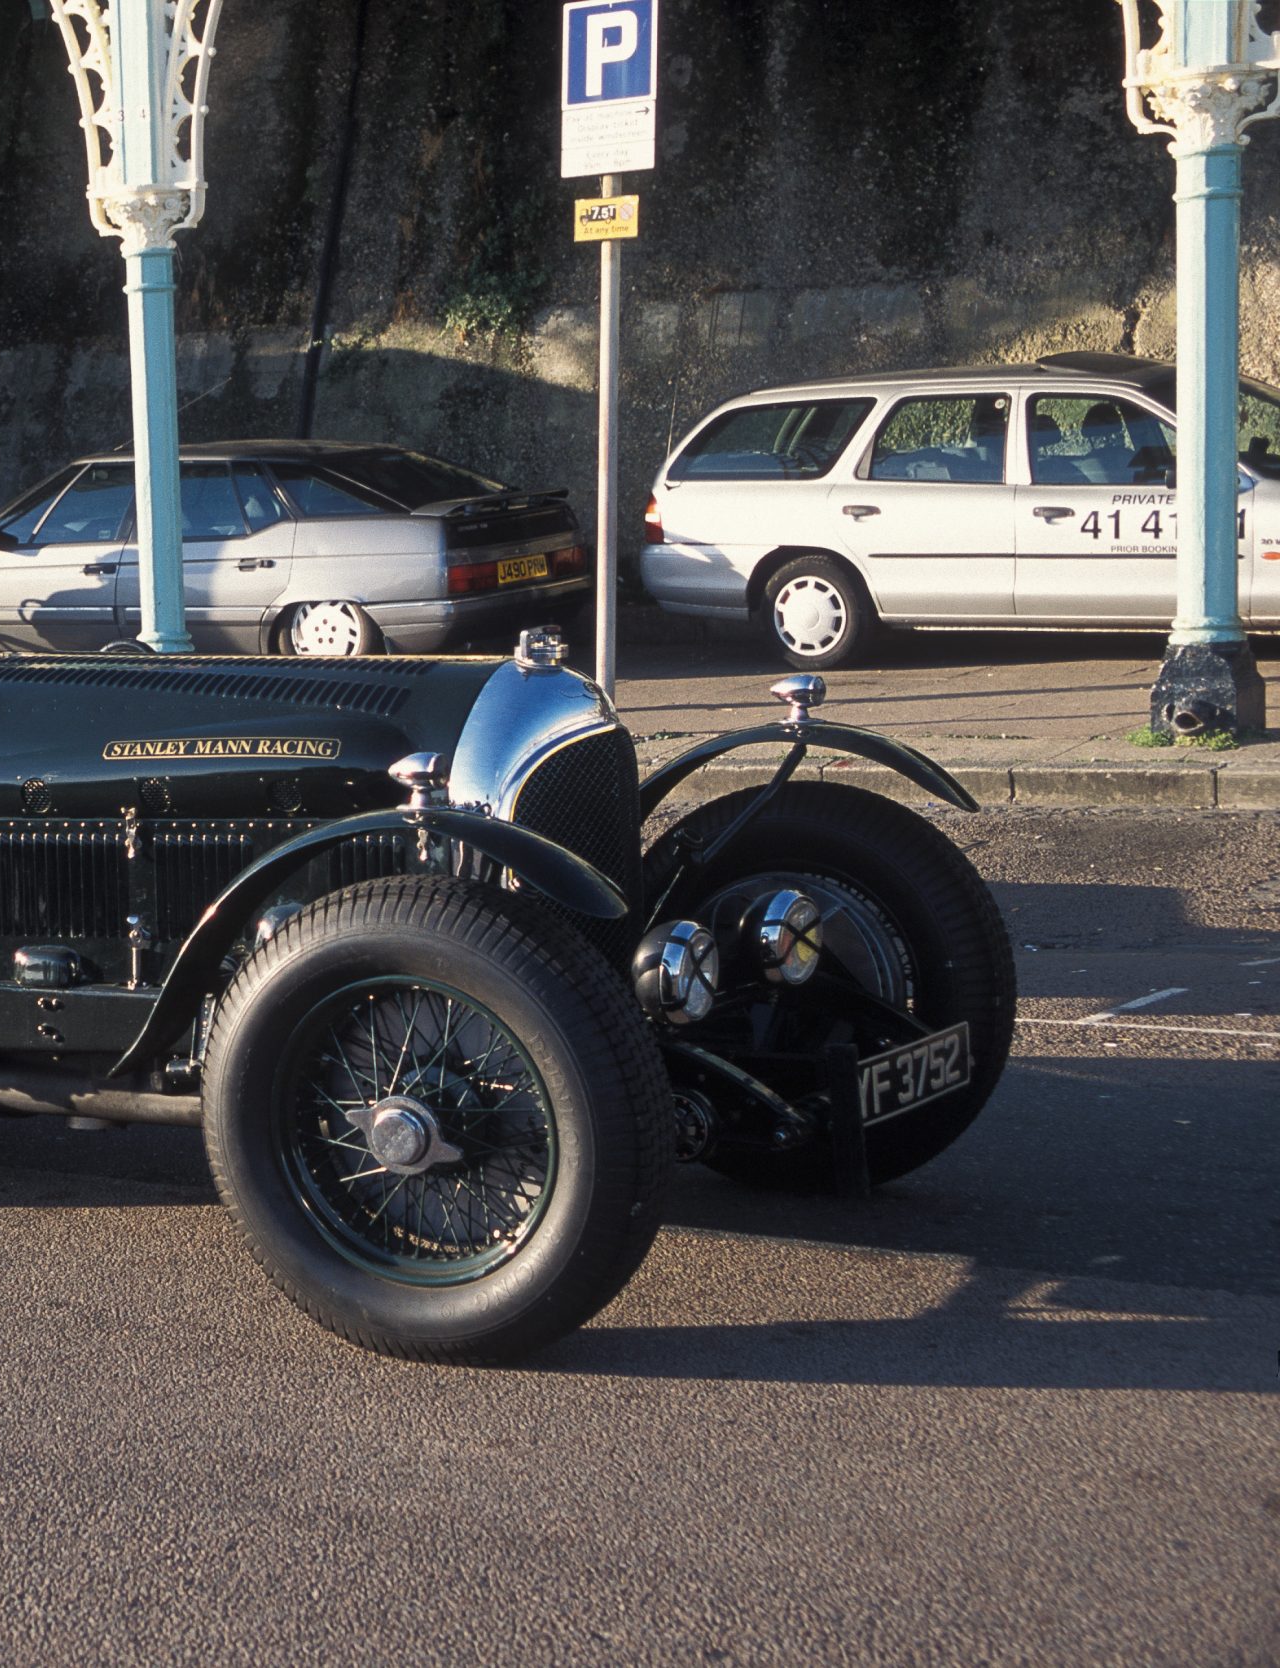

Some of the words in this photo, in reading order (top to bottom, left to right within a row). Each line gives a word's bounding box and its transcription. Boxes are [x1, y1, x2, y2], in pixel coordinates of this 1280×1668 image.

[586, 10, 638, 97] P
[591, 205, 616, 219] 7.5T
[595, 226, 609, 235] any
[611, 225, 629, 233] time
[1112, 494, 1176, 505] PRIVATE
[1080, 509, 1121, 539] 41
[1111, 545, 1139, 553] PRIOR
[1141, 544, 1177, 553] BOOKIN
[500, 560, 526, 580] J490
[528, 557, 546, 576] PRW
[111, 741, 190, 756] STANLEY
[194, 740, 252, 755] MANN
[256, 739, 334, 756] RACING
[896, 1033, 961, 1104] 3752
